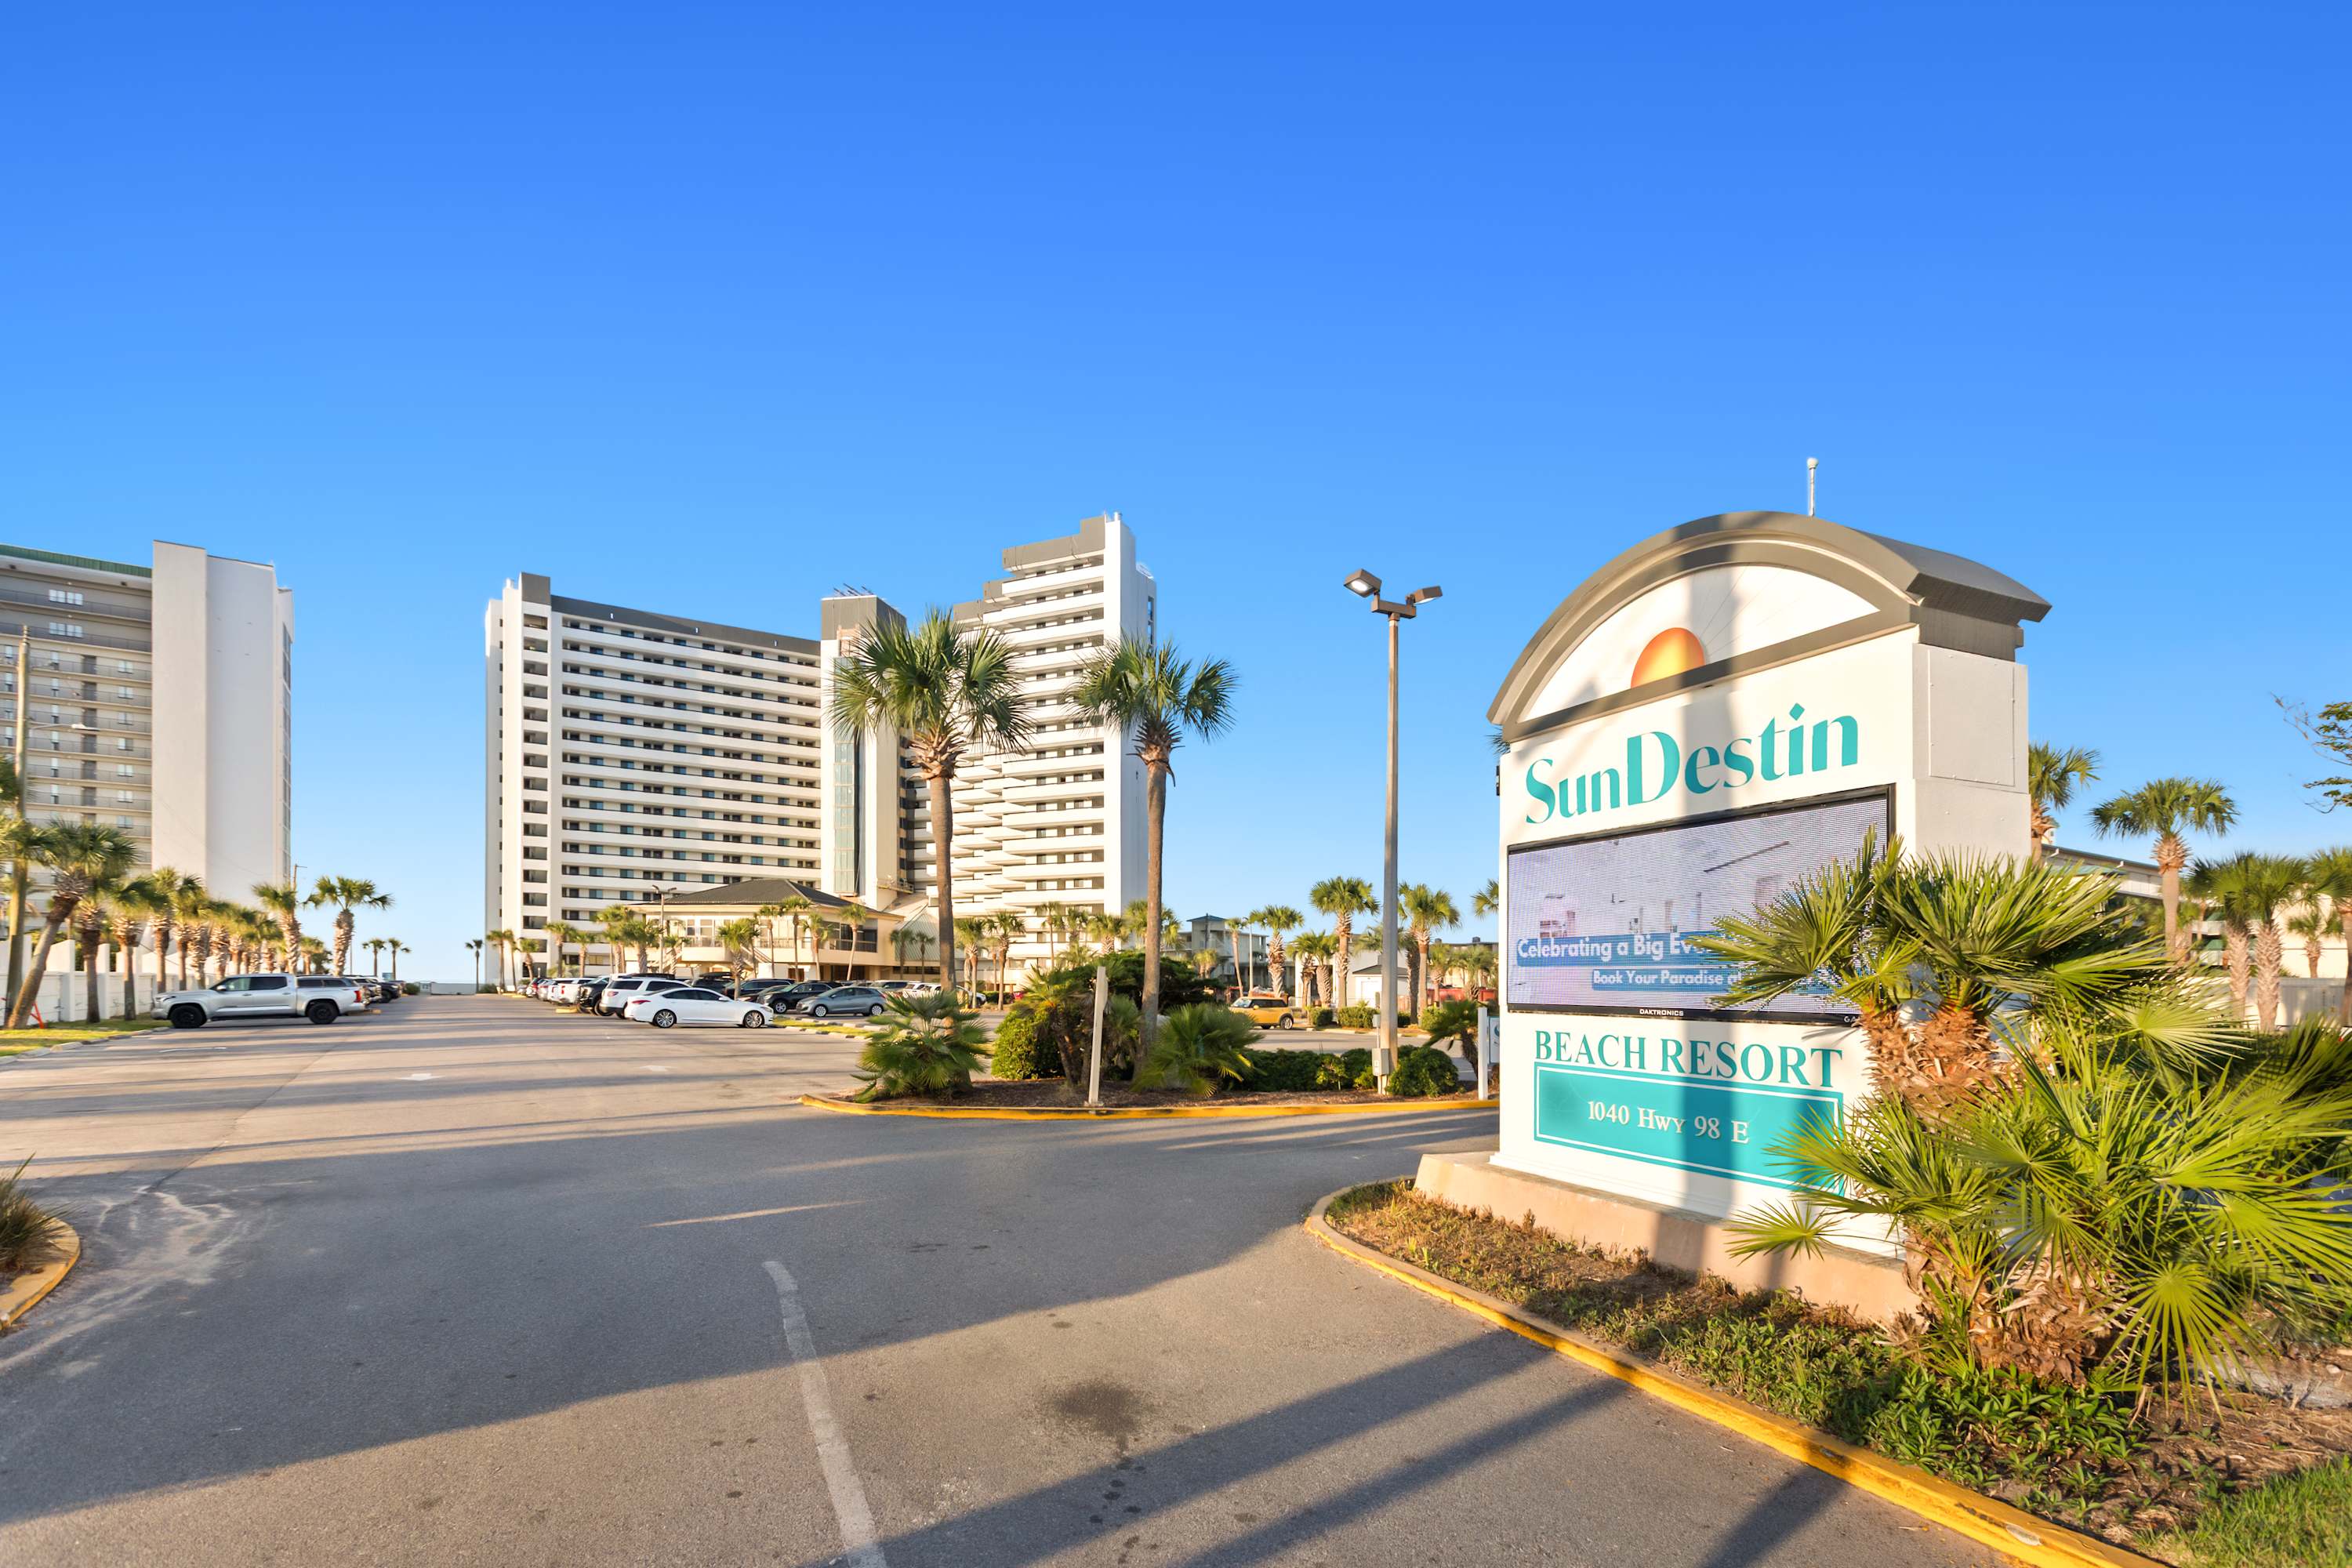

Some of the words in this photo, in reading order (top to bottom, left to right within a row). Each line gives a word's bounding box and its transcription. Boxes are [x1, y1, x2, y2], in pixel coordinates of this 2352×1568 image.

[1526, 703, 1858, 824] SunDestin
[1517, 937, 1612, 962] Celebrating
[1617, 942, 1628, 956] a
[1633, 934, 1664, 961] Big
[1593, 971, 1623, 985] Book
[1626, 970, 1658, 985] Your
[1661, 970, 1722, 985] Paradise
[1639, 1008, 1684, 1017] DAKTRONICS
[1534, 1029, 1646, 1070] BEACH
[1661, 1038, 1842, 1087] RESORT
[1588, 1100, 1630, 1125] 1040
[1695, 1116, 1720, 1139] 98
[1731, 1120, 1750, 1144] E
